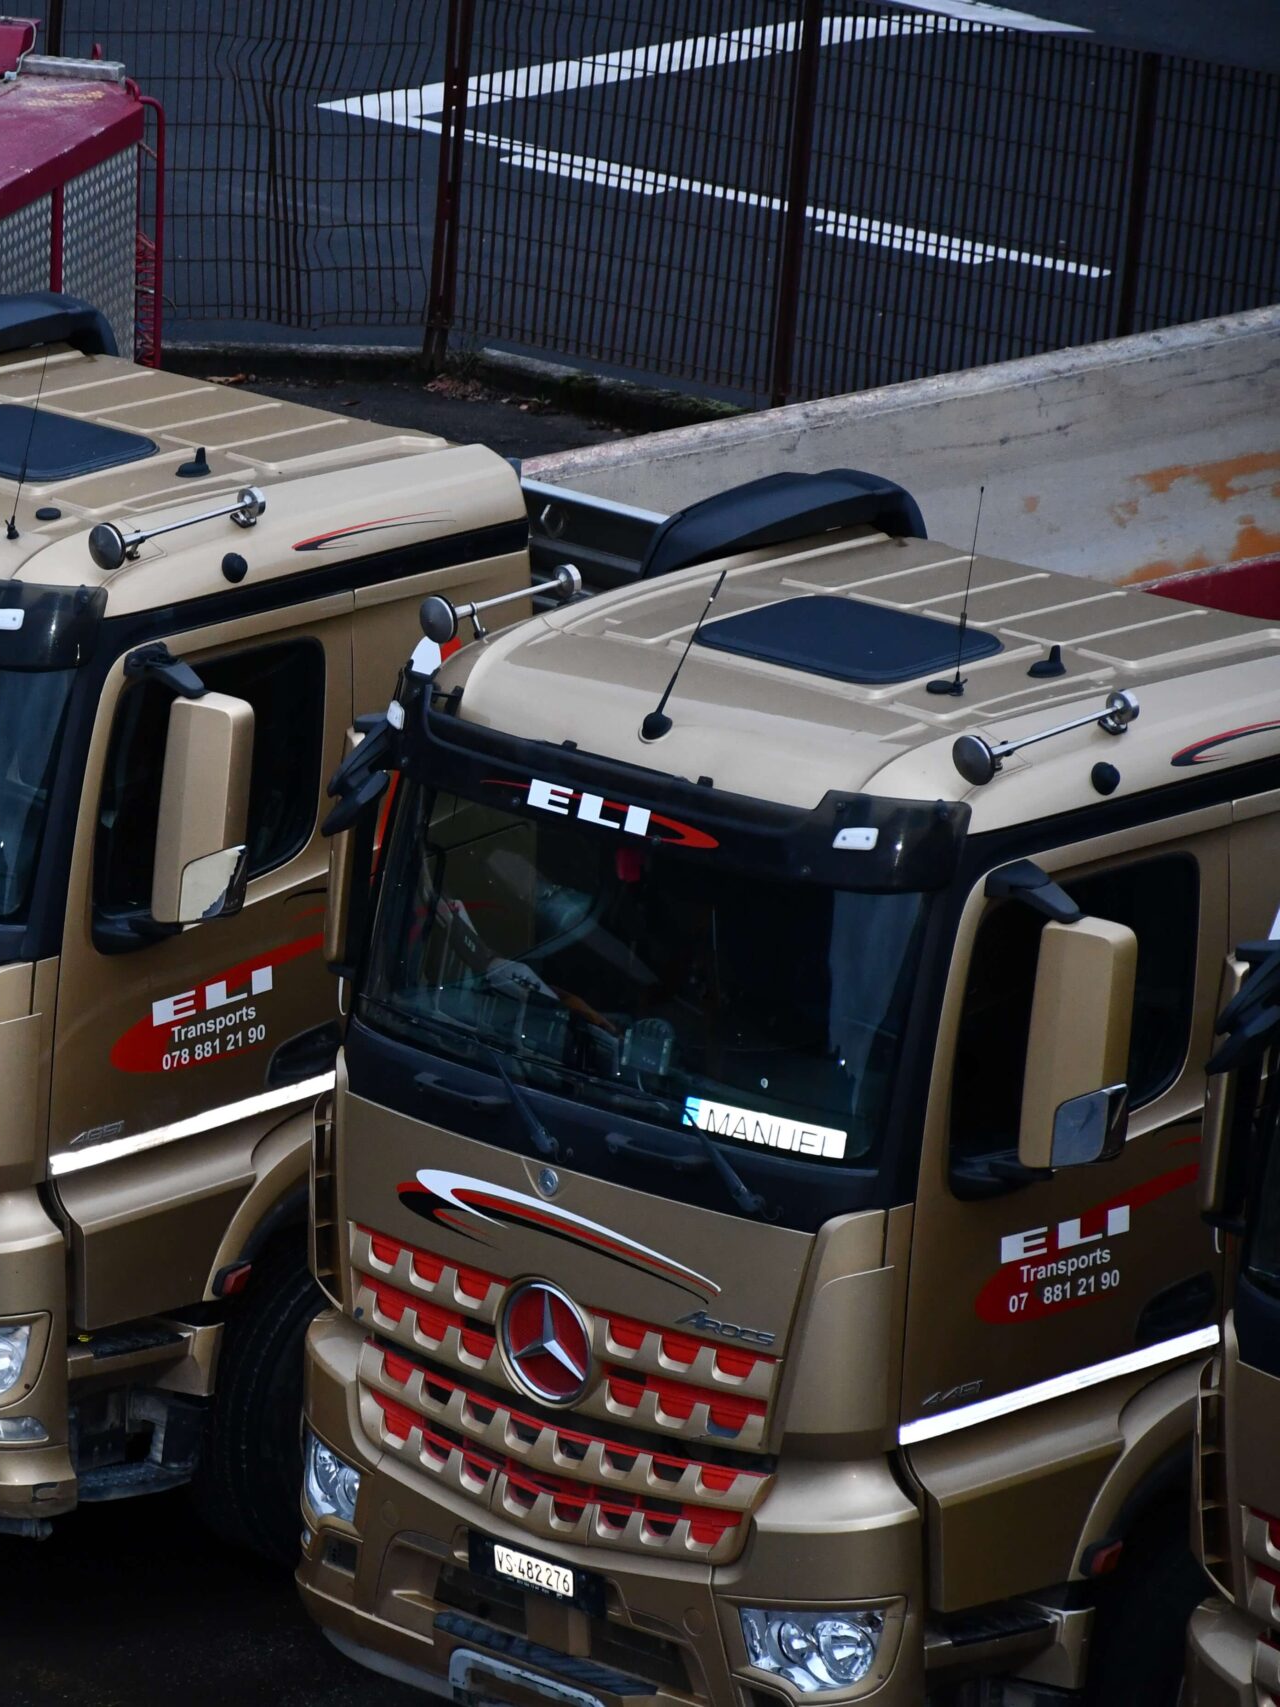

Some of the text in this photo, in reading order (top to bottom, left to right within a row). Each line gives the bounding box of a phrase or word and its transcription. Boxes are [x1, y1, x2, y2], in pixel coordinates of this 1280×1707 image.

[526, 778, 651, 837] ELI
[152, 965, 273, 1027] ELI
[162, 1024, 266, 1070] 078 881 21 90
[171, 1006, 256, 1043] Transports
[1001, 1204, 1131, 1265] ELI
[1020, 1248, 1111, 1284] Transports
[1043, 1281, 1071, 1305] 881
[1077, 1275, 1095, 1297] 21
[1101, 1269, 1120, 1290] 90
